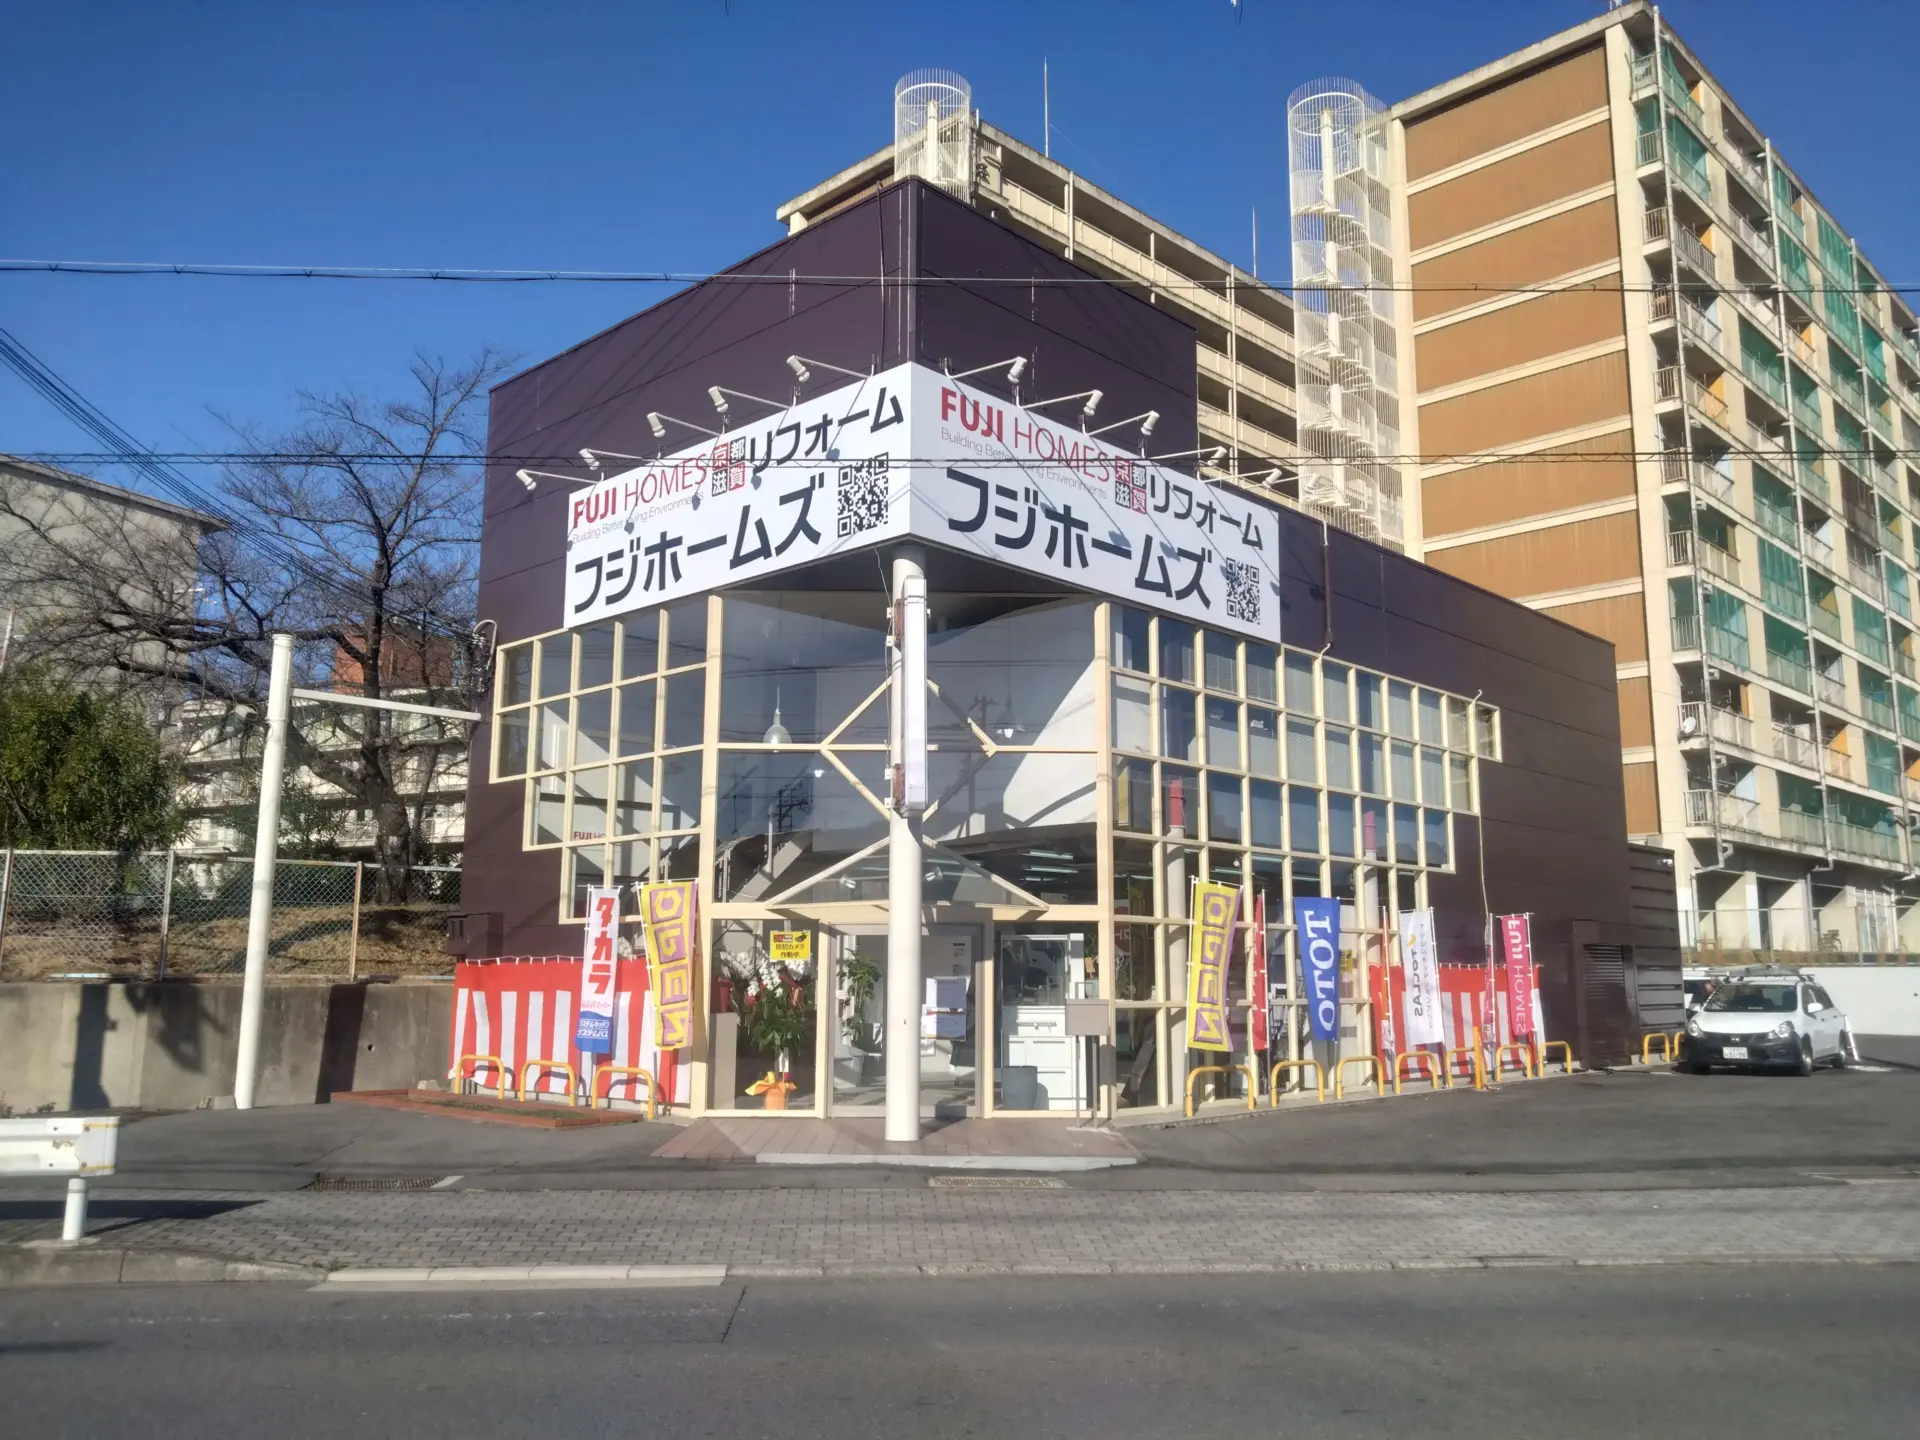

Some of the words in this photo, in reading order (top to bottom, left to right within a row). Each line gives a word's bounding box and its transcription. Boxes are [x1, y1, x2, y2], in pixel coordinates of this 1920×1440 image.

[750, 387, 904, 474] リフォーム
[941, 386, 1003, 443] FUJI
[1014, 417, 1110, 483] HOMES
[941, 426, 983, 456] Building
[986, 444, 1013, 464] Better
[1047, 466, 1108, 499] Environments
[572, 528, 601, 545] Building
[602, 519, 625, 535] Better
[649, 491, 704, 518] Environmes
[573, 487, 617, 529] FUJI
[624, 453, 708, 511] HOMES
[1150, 475, 1264, 551] リフォーム
[574, 472, 826, 615] フジホームズ
[946, 467, 1213, 610] フジホームズ
[573, 831, 592, 841] FUJI
[588, 897, 615, 994] タカラ
